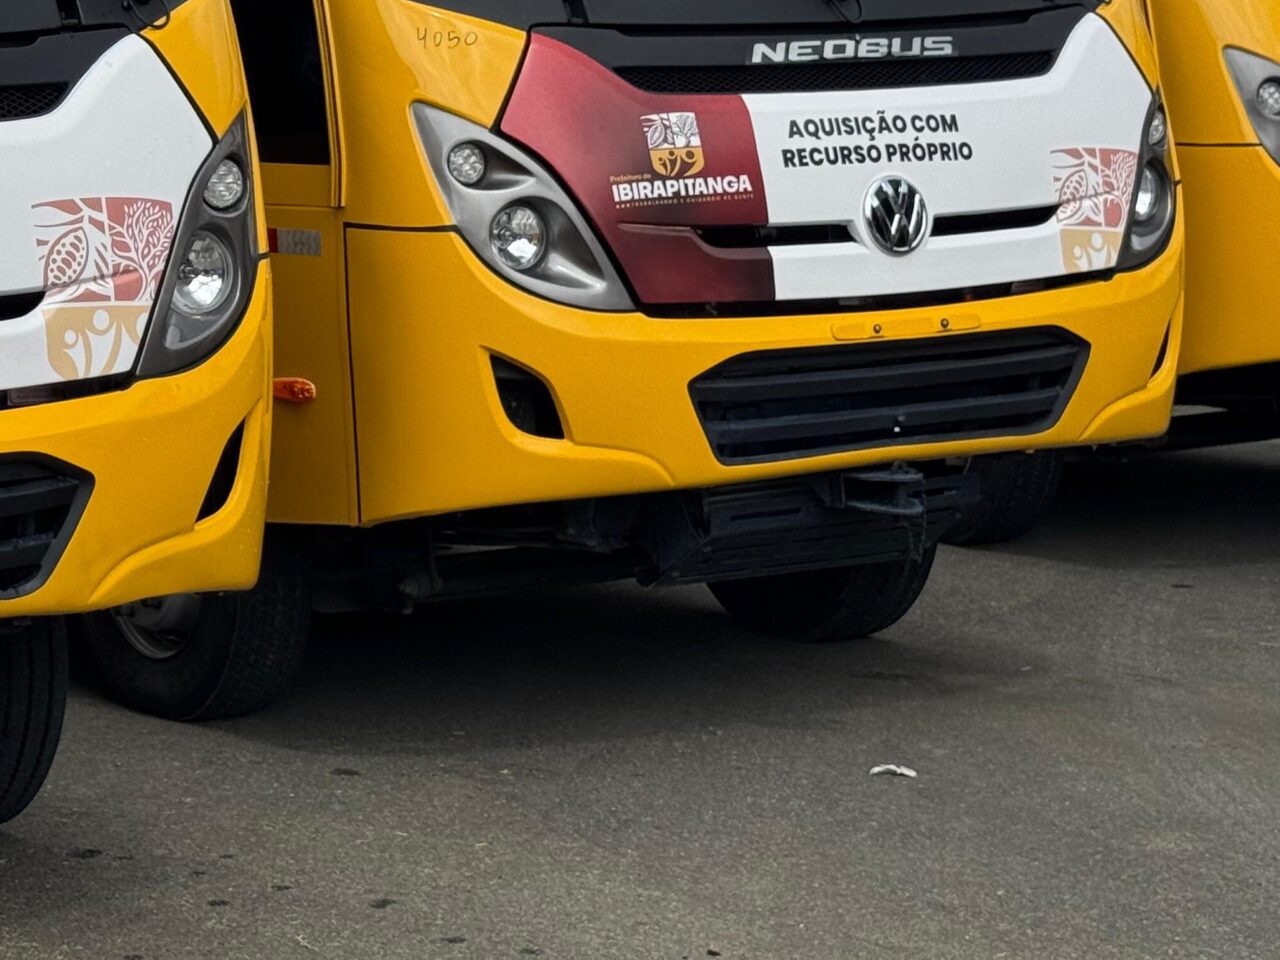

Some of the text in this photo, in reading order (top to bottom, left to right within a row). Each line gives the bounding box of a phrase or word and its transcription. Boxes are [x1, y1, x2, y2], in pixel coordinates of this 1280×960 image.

[416, 26, 479, 50] 4050
[752, 36, 953, 64] NEOBUS
[788, 109, 959, 142] AQUISIÇÃO COM
[781, 136, 973, 168] RECURSO PRÓPRIO
[612, 174, 753, 203] IBIRAPITANGA
